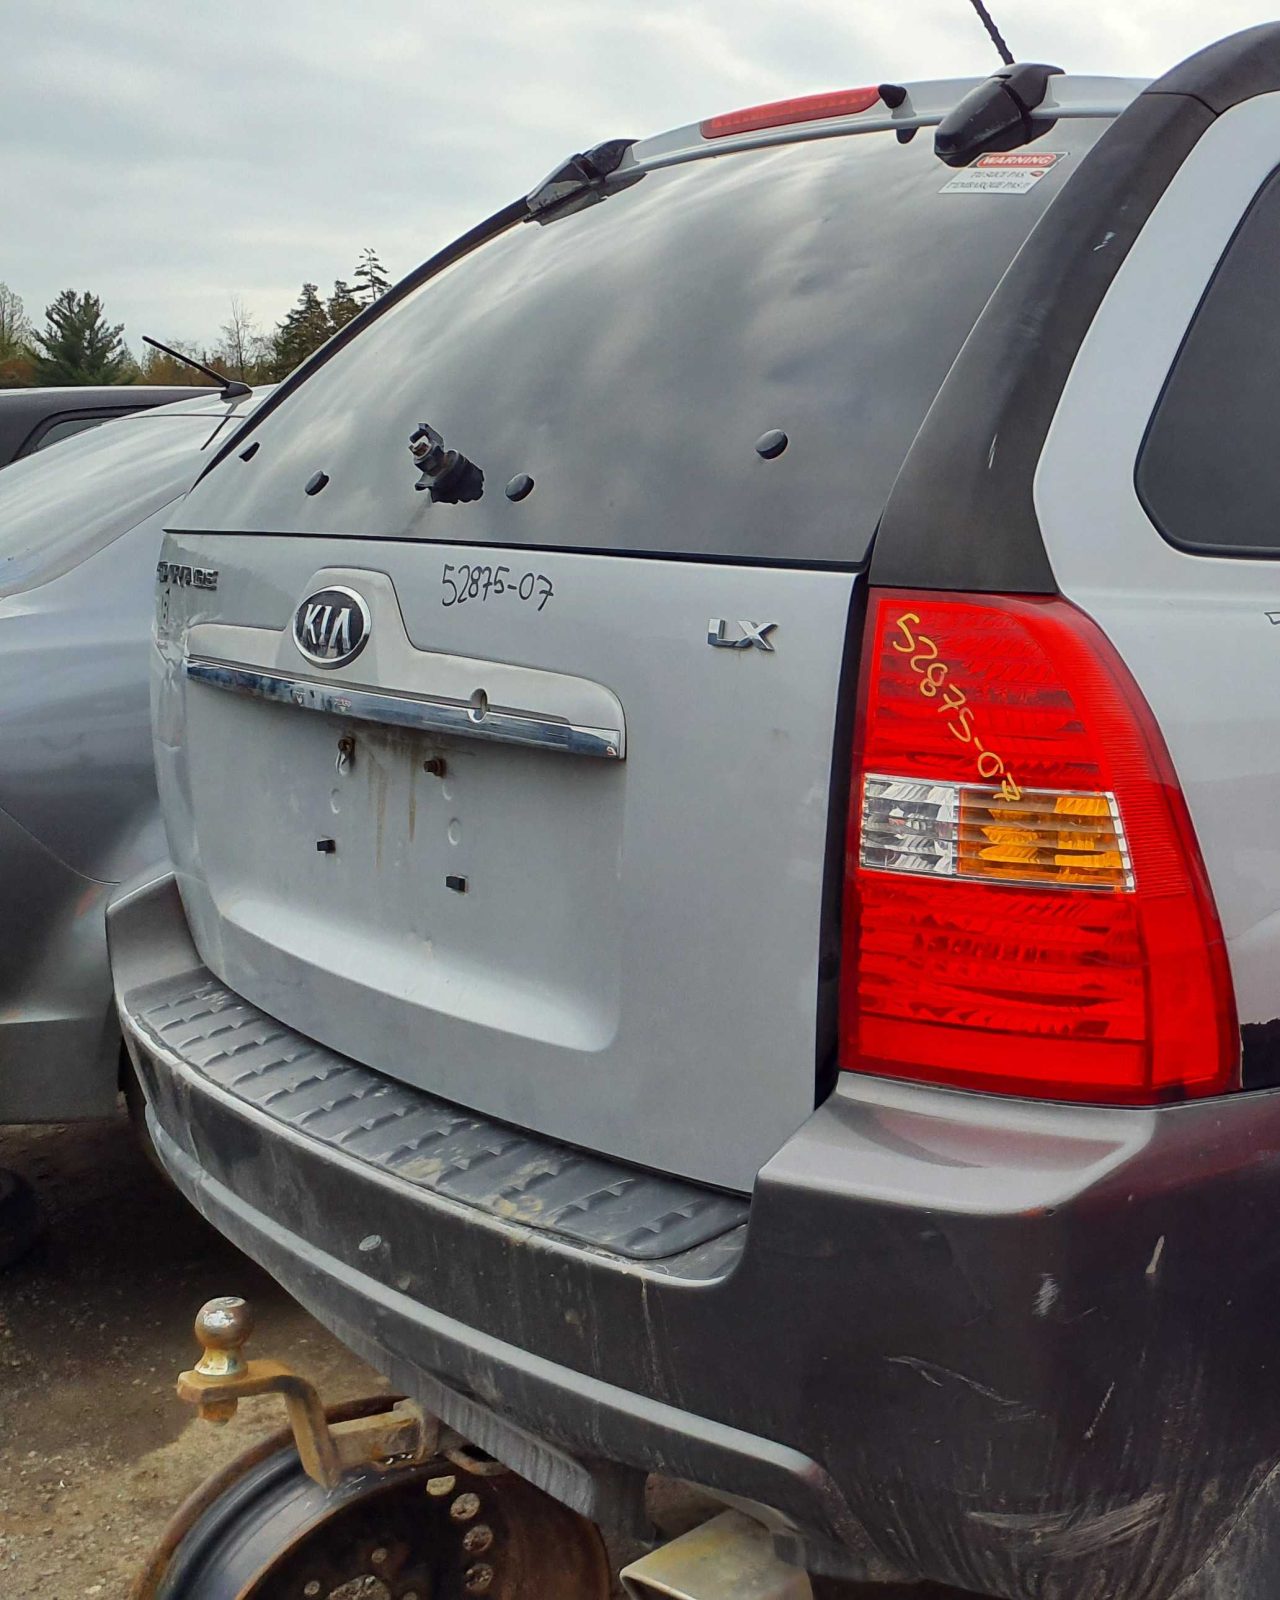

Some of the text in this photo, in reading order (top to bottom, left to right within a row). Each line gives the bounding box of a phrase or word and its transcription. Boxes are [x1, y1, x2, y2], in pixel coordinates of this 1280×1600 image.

[981, 154, 1052, 165] WARNING
[442, 563, 554, 612] 52875-07
[300, 603, 352, 659] KIA
[707, 618, 778, 652] LX
[893, 613, 1022, 802] 52875-07
